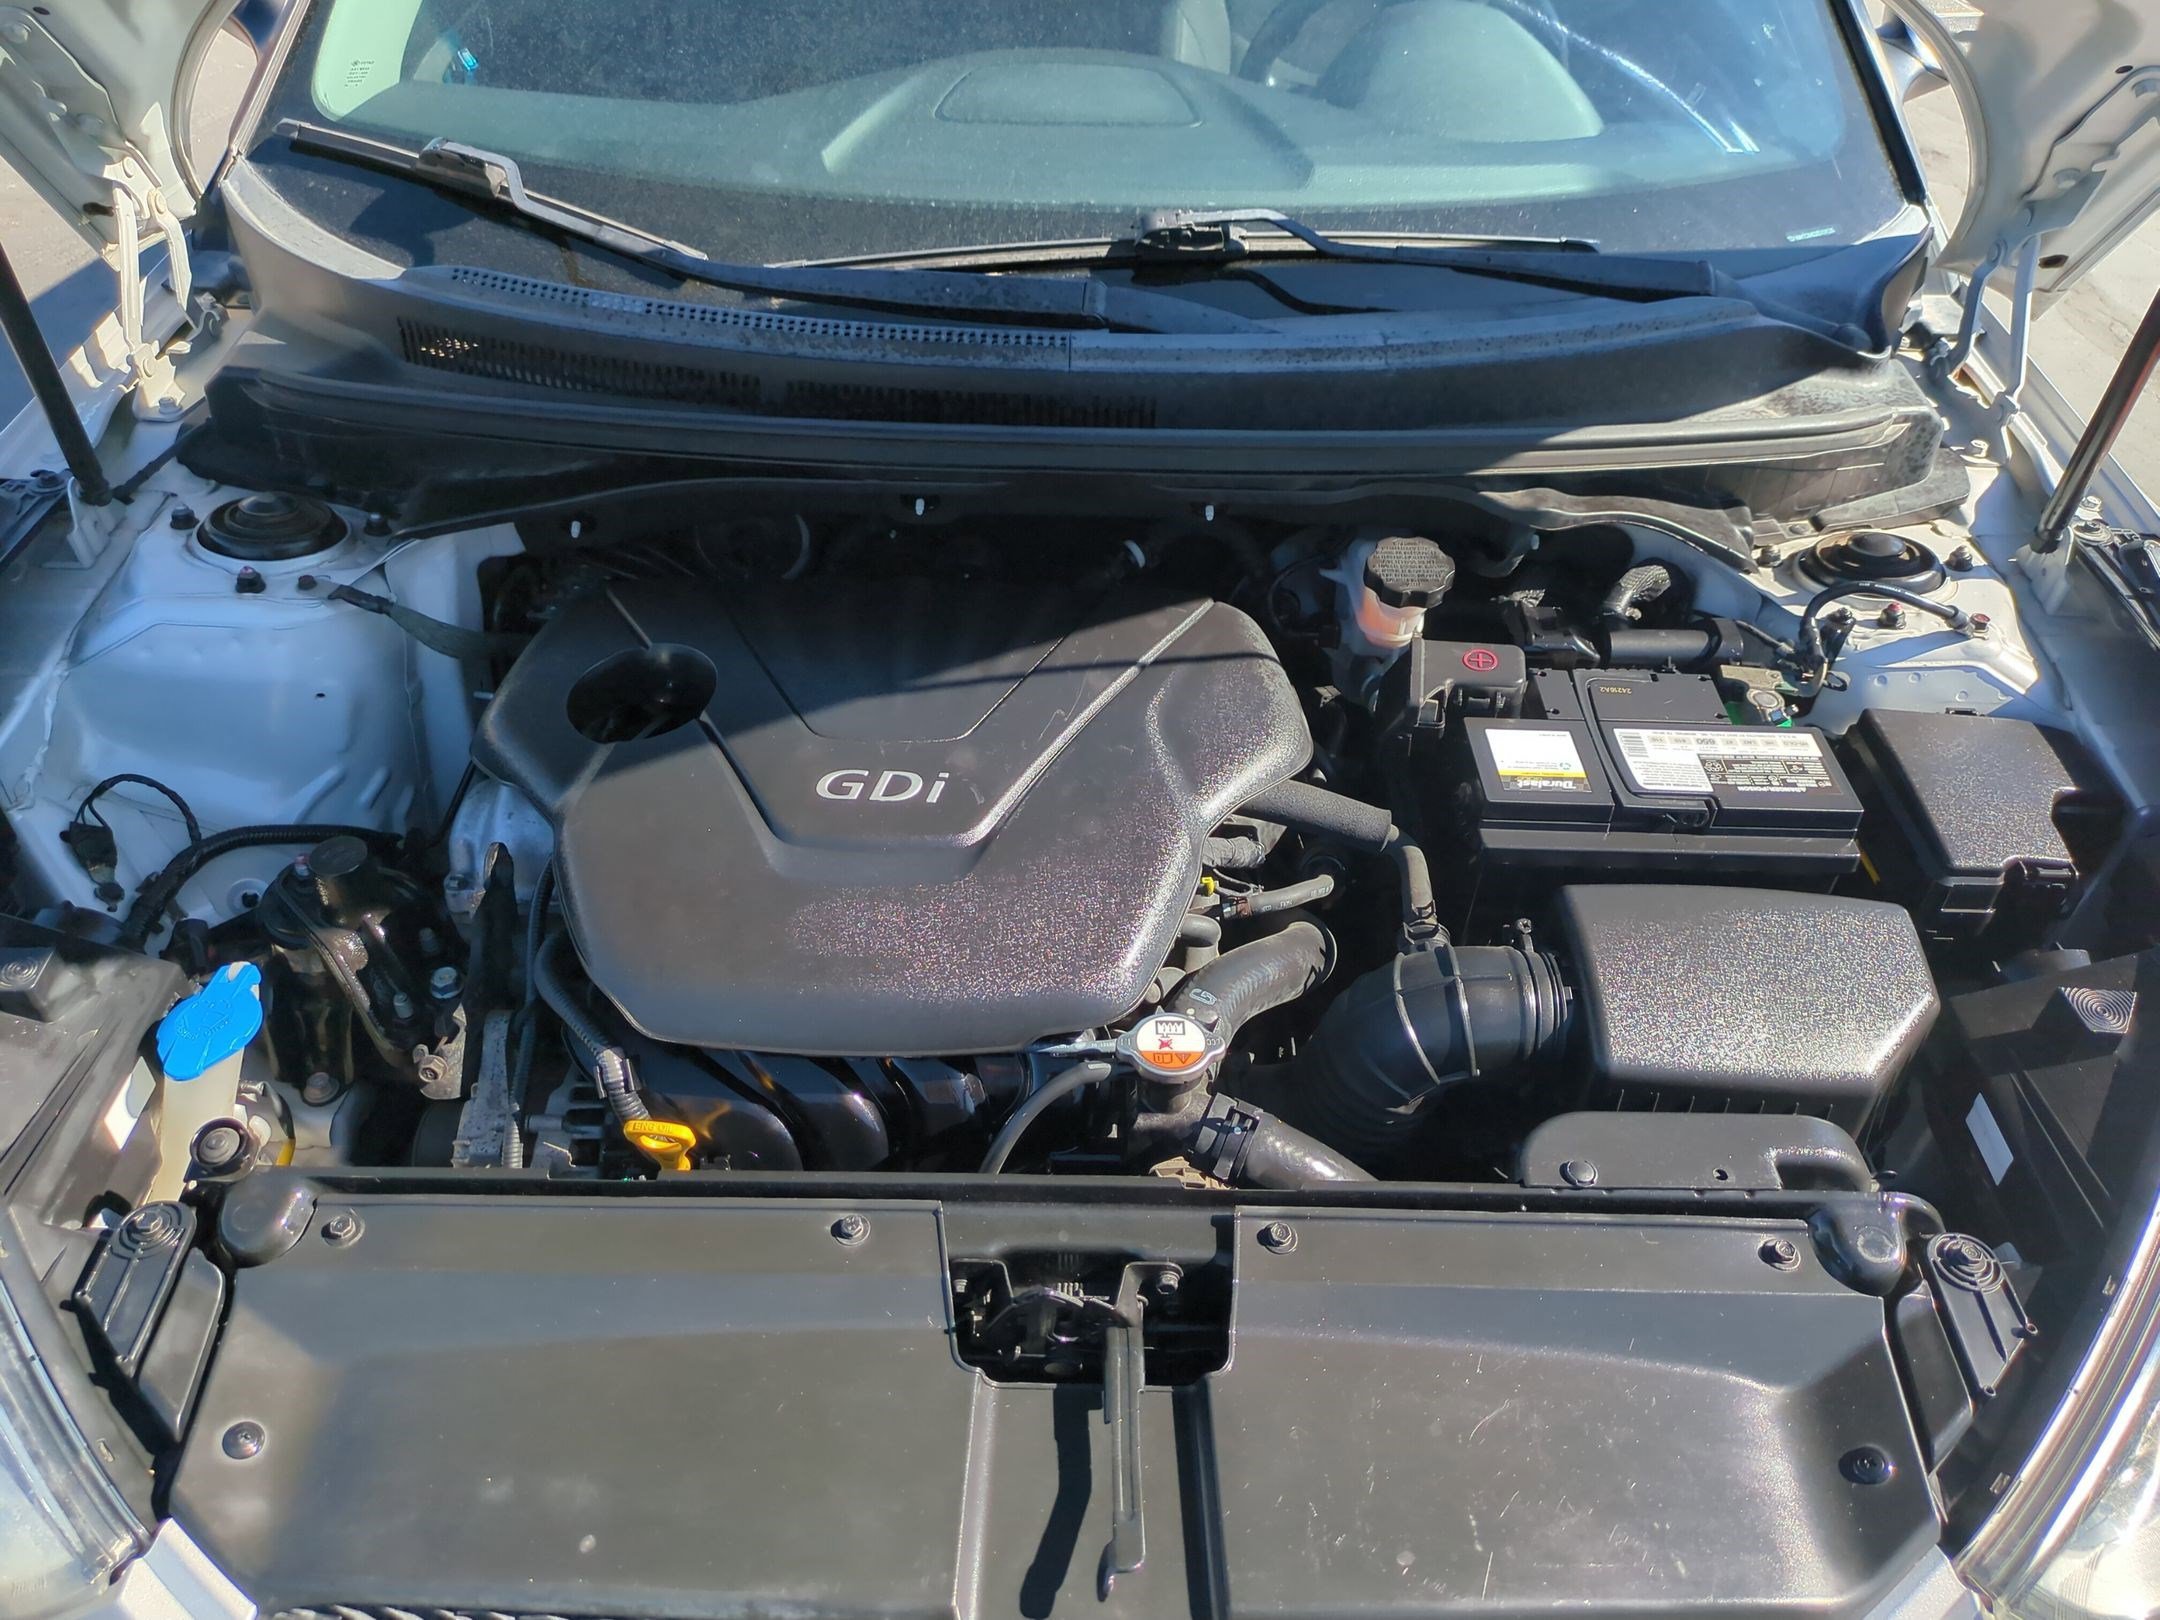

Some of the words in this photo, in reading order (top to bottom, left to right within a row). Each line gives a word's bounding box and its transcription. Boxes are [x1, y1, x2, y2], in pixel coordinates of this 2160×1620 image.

[815, 769, 950, 803] GDi
[1516, 779, 1577, 790] Duralast
[632, 1122, 654, 1131] ENG
